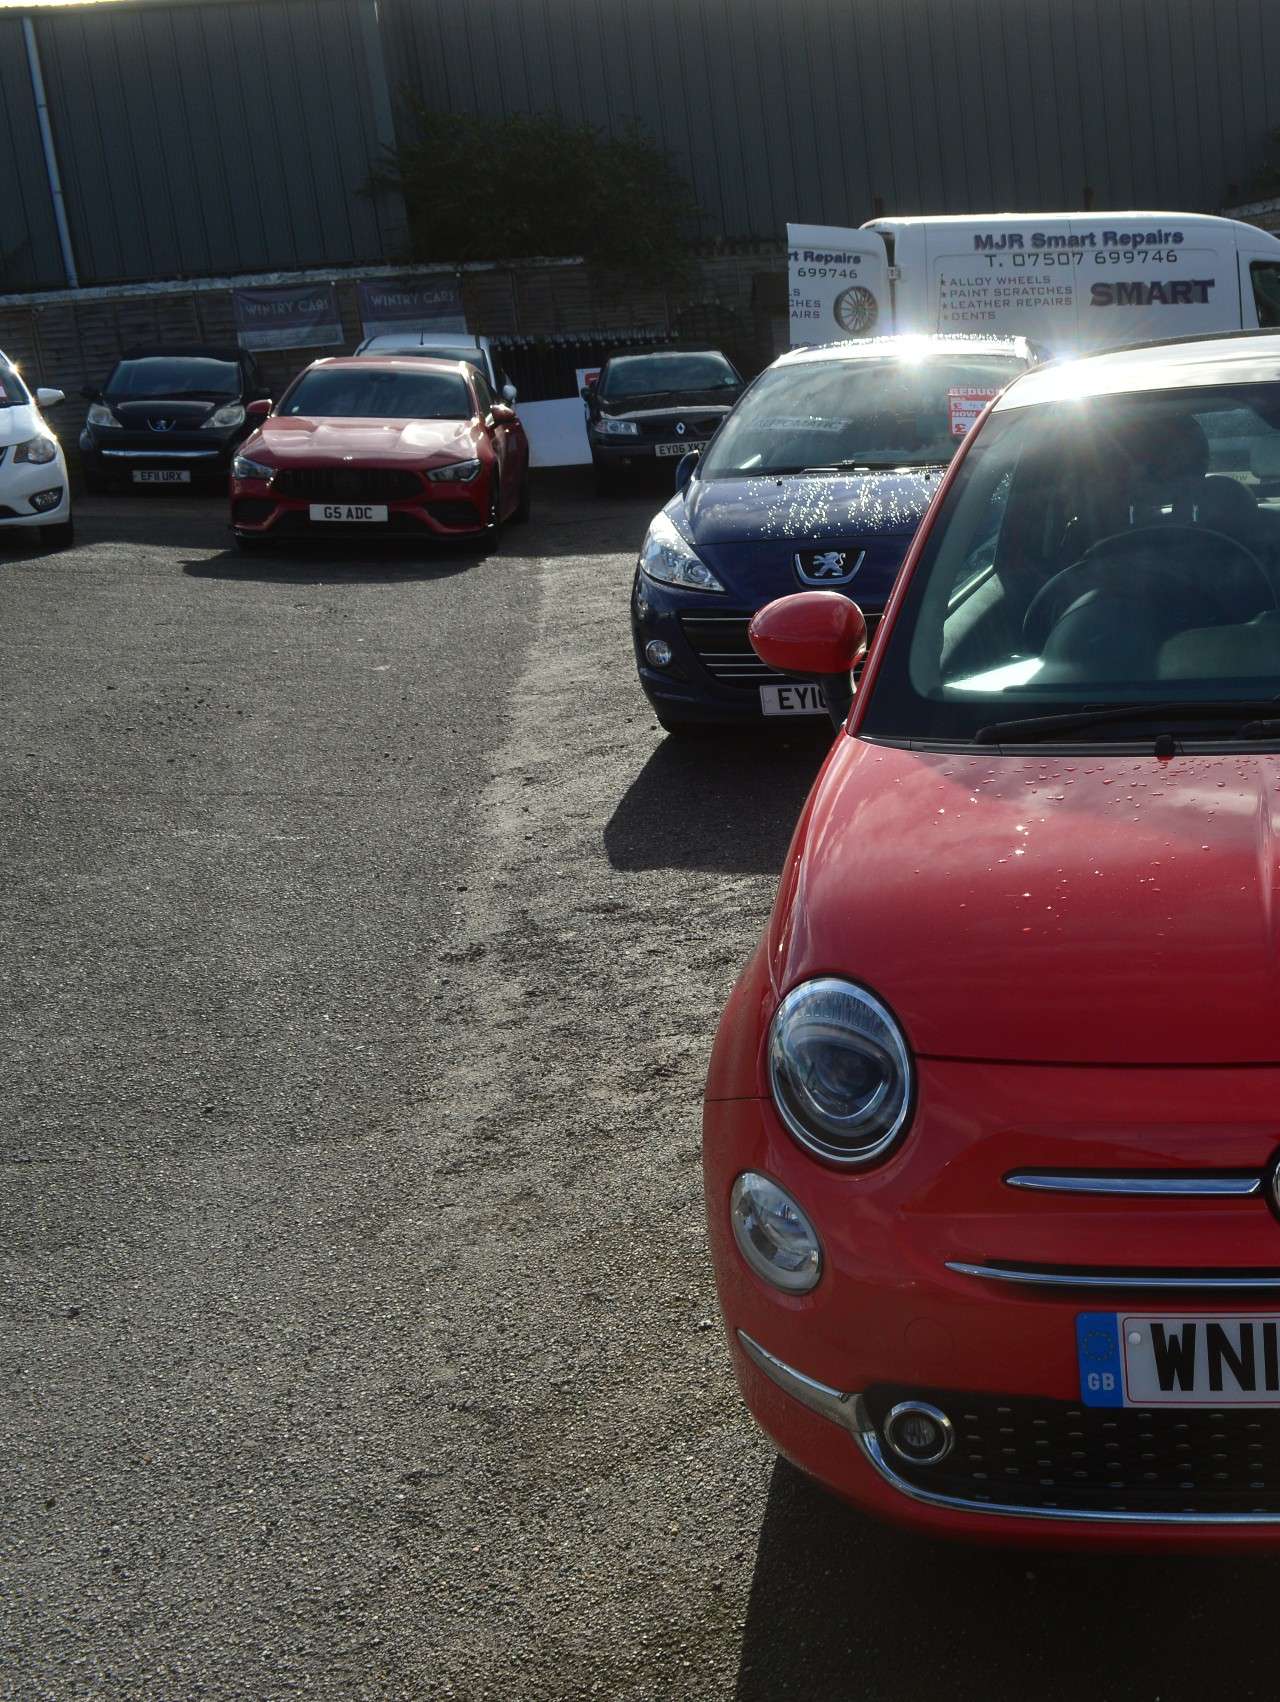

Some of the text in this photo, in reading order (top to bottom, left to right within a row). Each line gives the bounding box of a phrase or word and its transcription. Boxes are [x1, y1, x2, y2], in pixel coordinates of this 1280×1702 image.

[974, 229, 1184, 250] MJR Smart Repairs
[803, 251, 862, 265] Repairs
[1012, 252, 1084, 267] 07507
[1094, 250, 1178, 265] 699746
[797, 267, 859, 279] 699746
[949, 275, 1052, 287] ALLOY WHEELS
[950, 286, 1073, 298] PAINT SCRATCHES
[1090, 278, 1215, 306] SMART
[951, 297, 1073, 309] LEATHER REPAIRS
[951, 311, 996, 321] DENTS
[162, 471, 182, 481] URX
[324, 506, 373, 520] G5 ADC
[1087, 1372, 1115, 1392] GB
